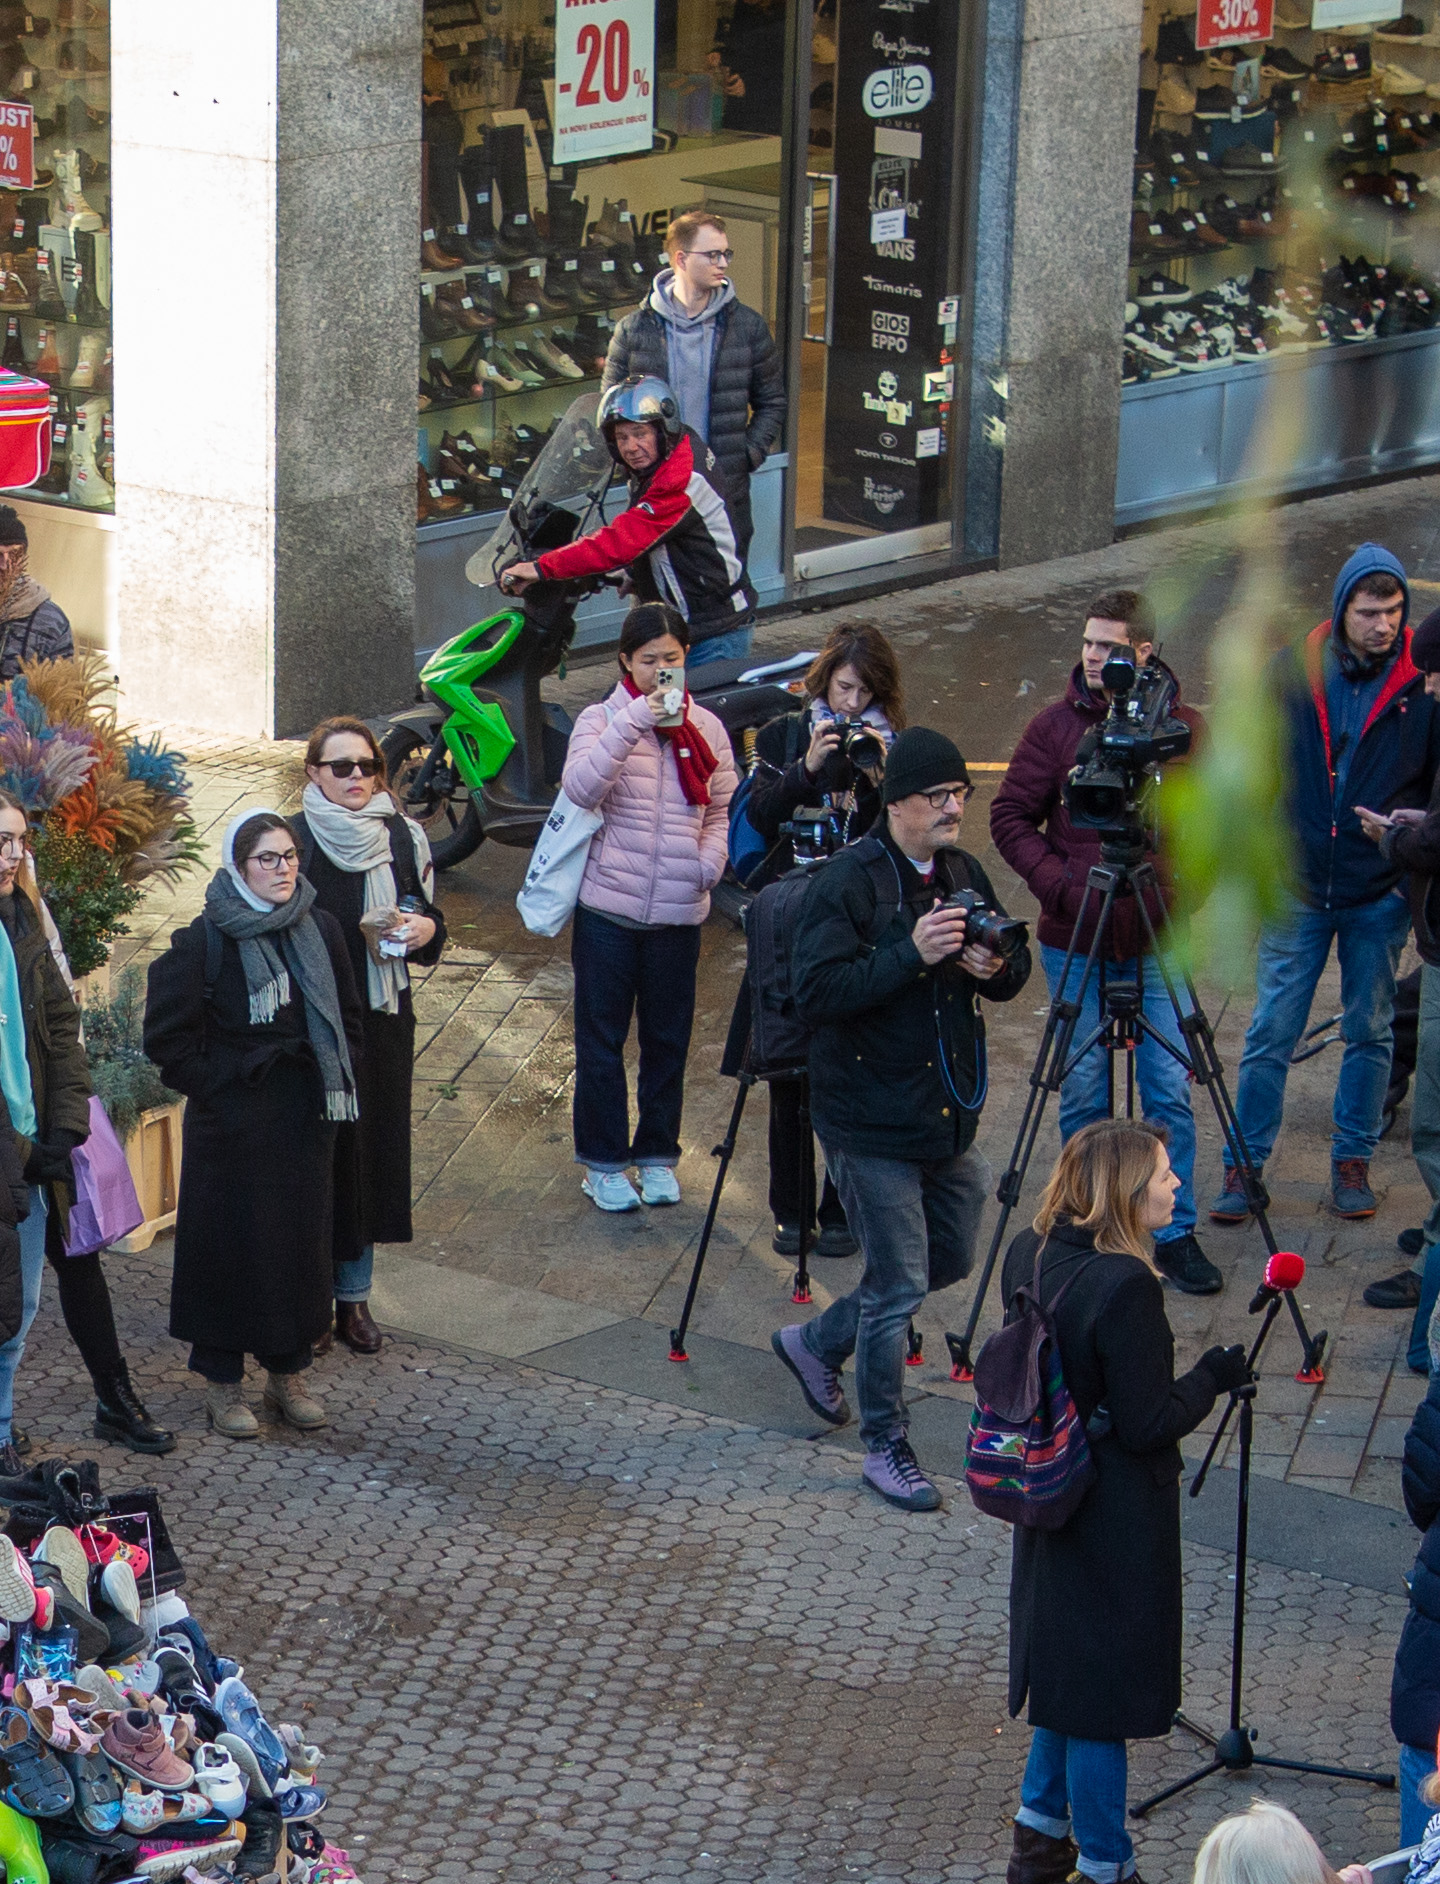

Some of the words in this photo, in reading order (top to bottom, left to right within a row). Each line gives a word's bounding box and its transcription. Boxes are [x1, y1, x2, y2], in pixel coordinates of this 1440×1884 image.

[1212, 0, 1259, 30] -30%
[559, 20, 650, 107] -20%
[871, 67, 924, 109] elite
[875, 239, 916, 261] VANS
[863, 275, 922, 298] Tamaris
[873, 313, 908, 333] GIOS
[872, 332, 908, 353] EPPO
[855, 449, 880, 459] TOM
[881, 453, 917, 467] TAILOR
